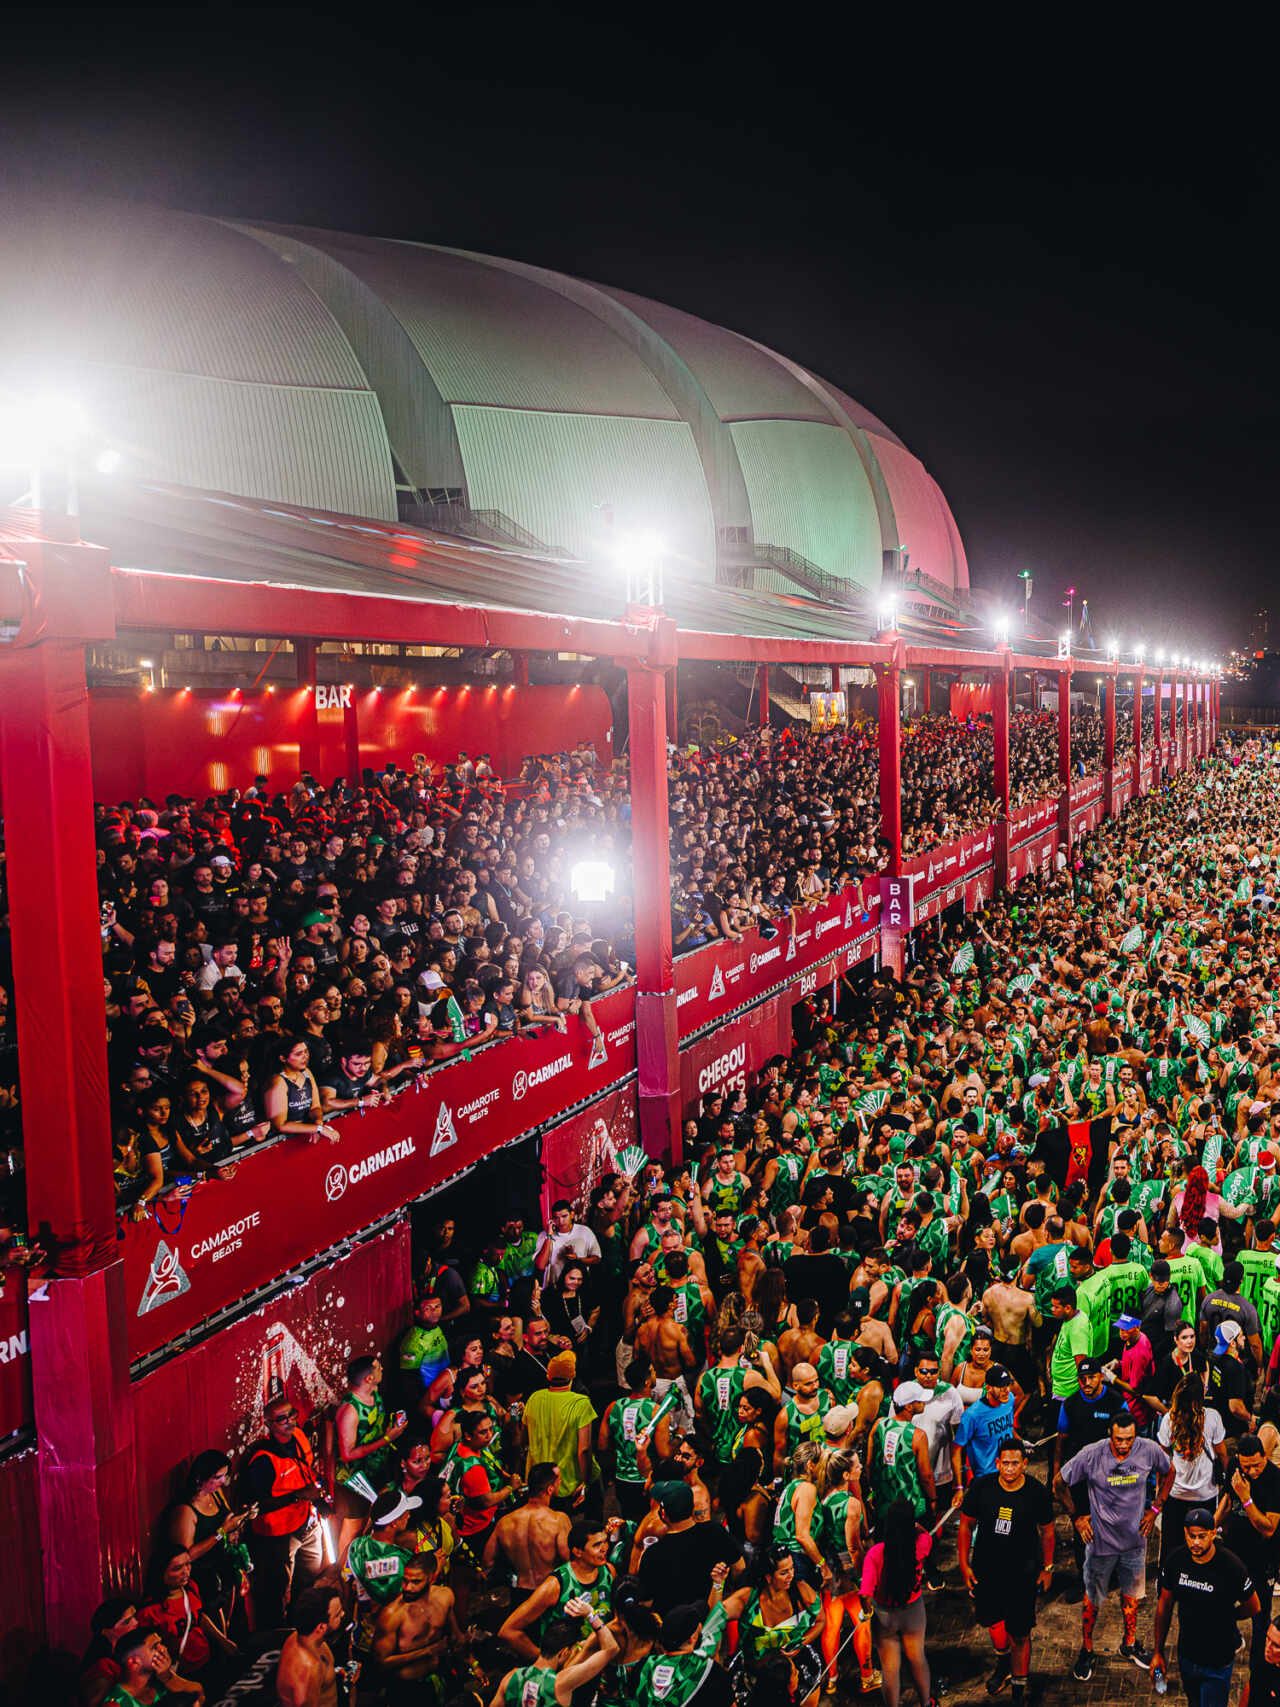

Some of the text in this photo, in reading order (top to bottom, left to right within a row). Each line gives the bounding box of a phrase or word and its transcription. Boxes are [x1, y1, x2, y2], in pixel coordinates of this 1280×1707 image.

[315, 684, 352, 710] BAR
[889, 883, 901, 925] BAR
[946, 889, 956, 903] BAR
[918, 904, 929, 921] BAR
[847, 945, 862, 966] BAR
[800, 972, 817, 996] BAR
[527, 1053, 573, 1087] CARNATAL
[698, 1042, 746, 1094] CHEGOU
[457, 1088, 500, 1119] CAMAROTE
[468, 1107, 489, 1124] BEATS
[349, 1137, 416, 1183] CARNATAL
[191, 1211, 262, 1259] CAMAROTE
[212, 1238, 243, 1263] BEATS
